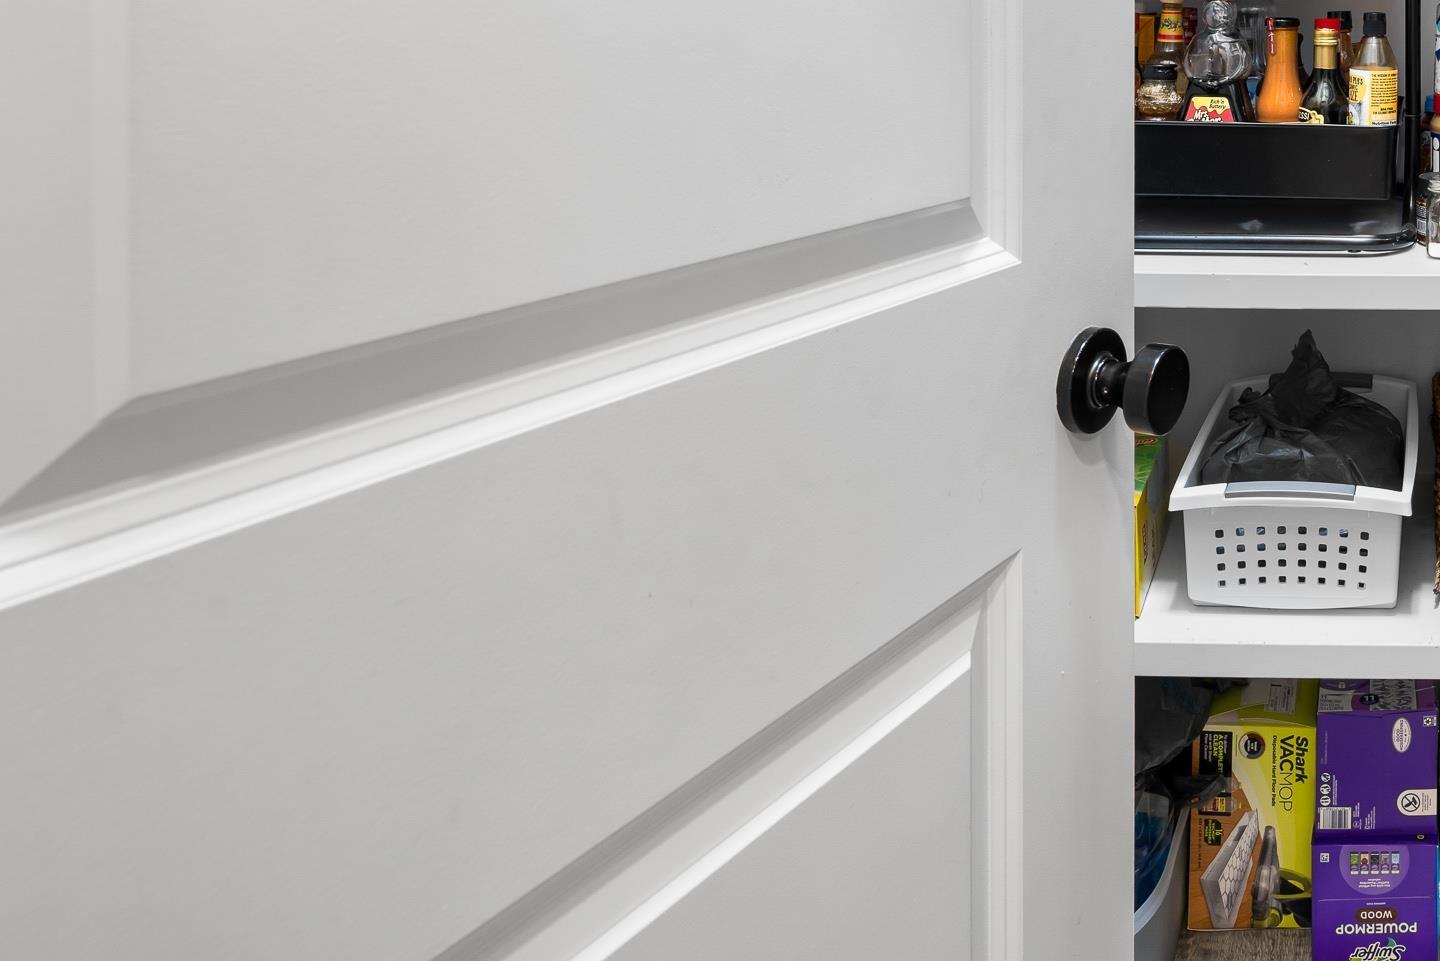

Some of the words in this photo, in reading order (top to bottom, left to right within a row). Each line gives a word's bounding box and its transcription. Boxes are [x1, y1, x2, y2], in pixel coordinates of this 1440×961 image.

[1295, 735, 1309, 784] Shark
[1278, 734, 1294, 813] VACMOP
[1215, 828, 1224, 837] 16
[1360, 910, 1393, 920] WOOD
[1335, 921, 1418, 935] POWERMOP
